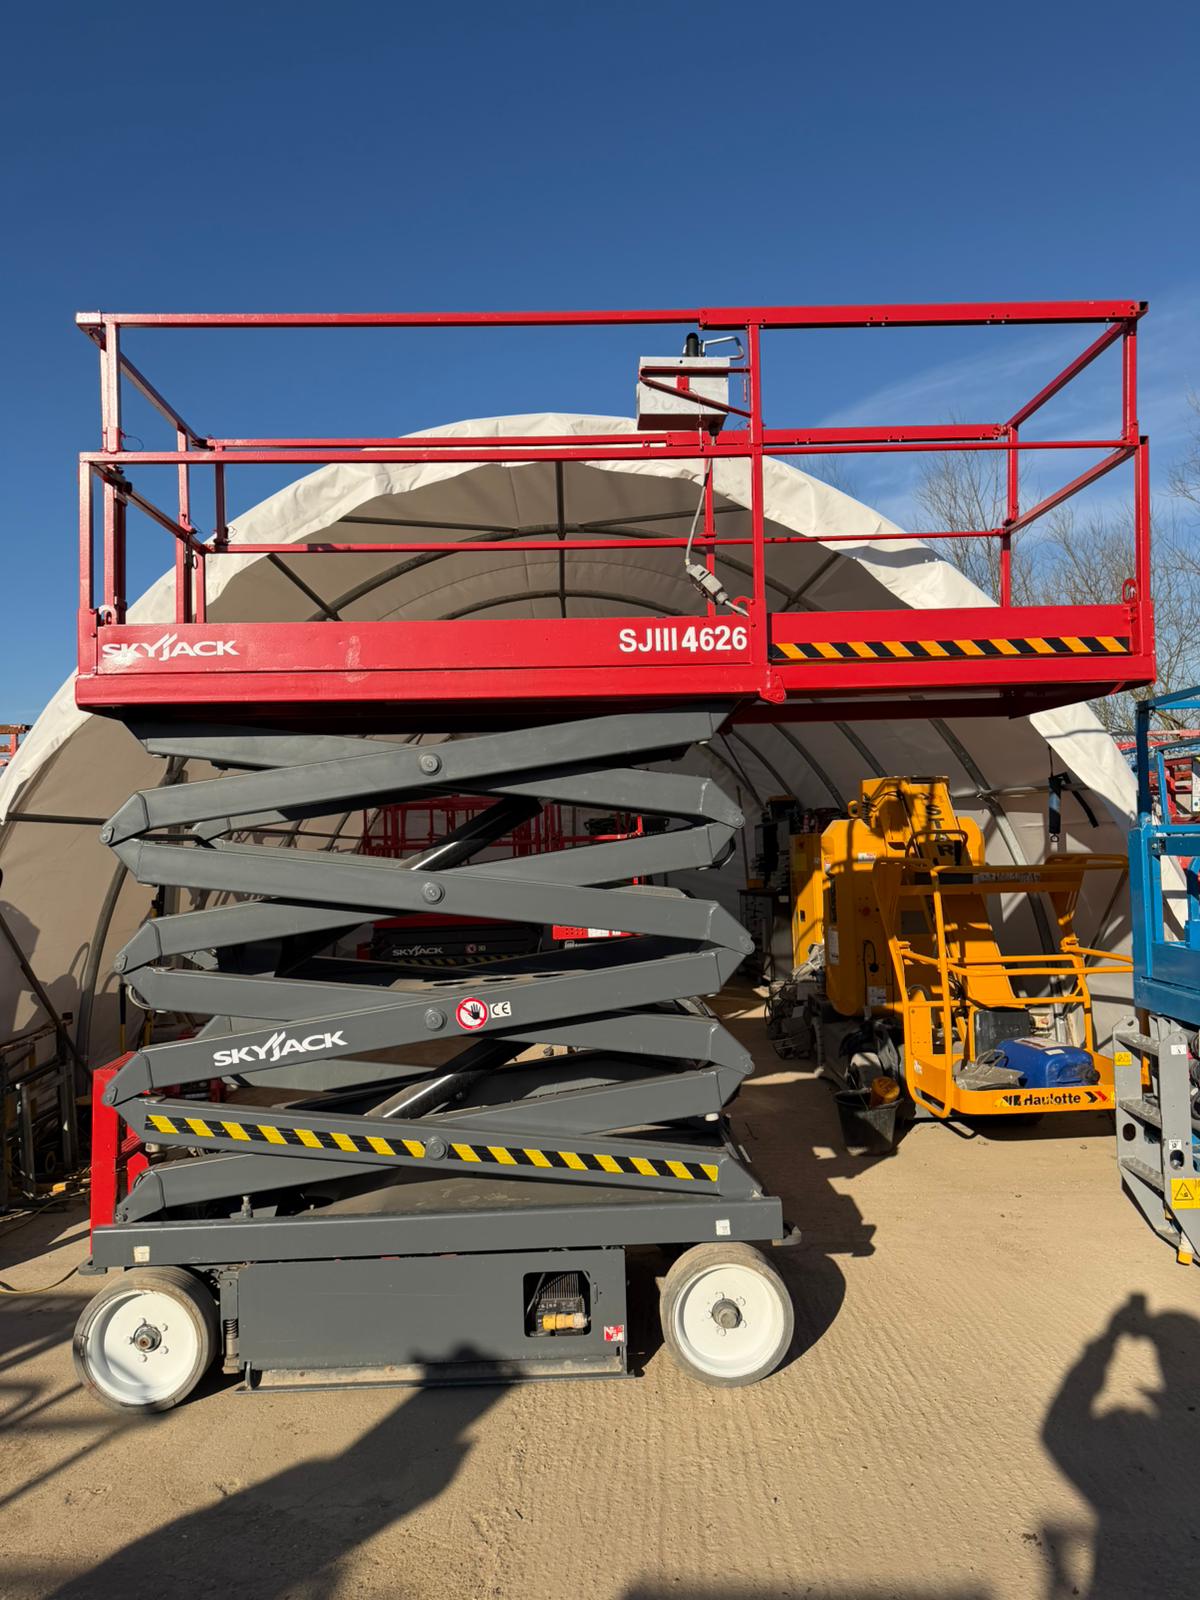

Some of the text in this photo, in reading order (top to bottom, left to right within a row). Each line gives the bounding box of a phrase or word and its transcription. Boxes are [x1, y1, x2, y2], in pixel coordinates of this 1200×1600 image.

[102, 632, 240, 661] SKYJACK
[392, 944, 444, 957] SKYJACK
[213, 1030, 348, 1067] SKYJACK
